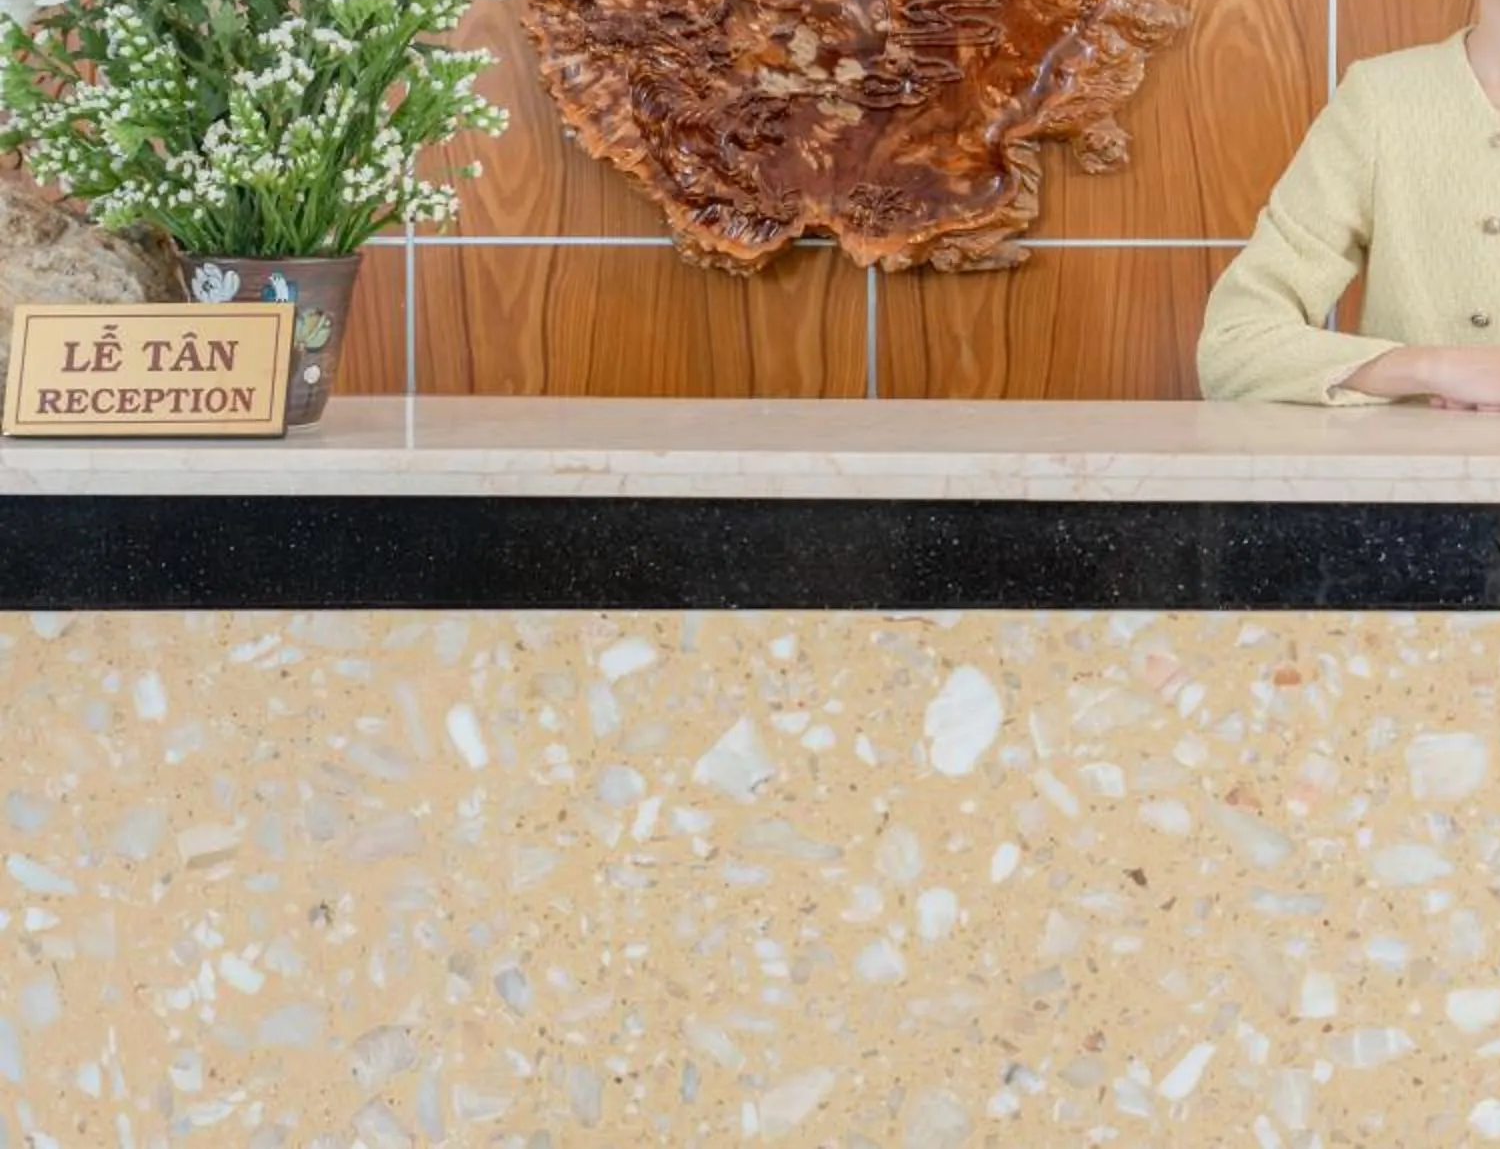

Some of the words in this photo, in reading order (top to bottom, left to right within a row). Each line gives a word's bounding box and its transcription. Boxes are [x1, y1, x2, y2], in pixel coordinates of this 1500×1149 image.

[61, 324, 123, 372] LỄ
[143, 332, 239, 372] TÂN
[36, 387, 256, 414] RECEPTION
